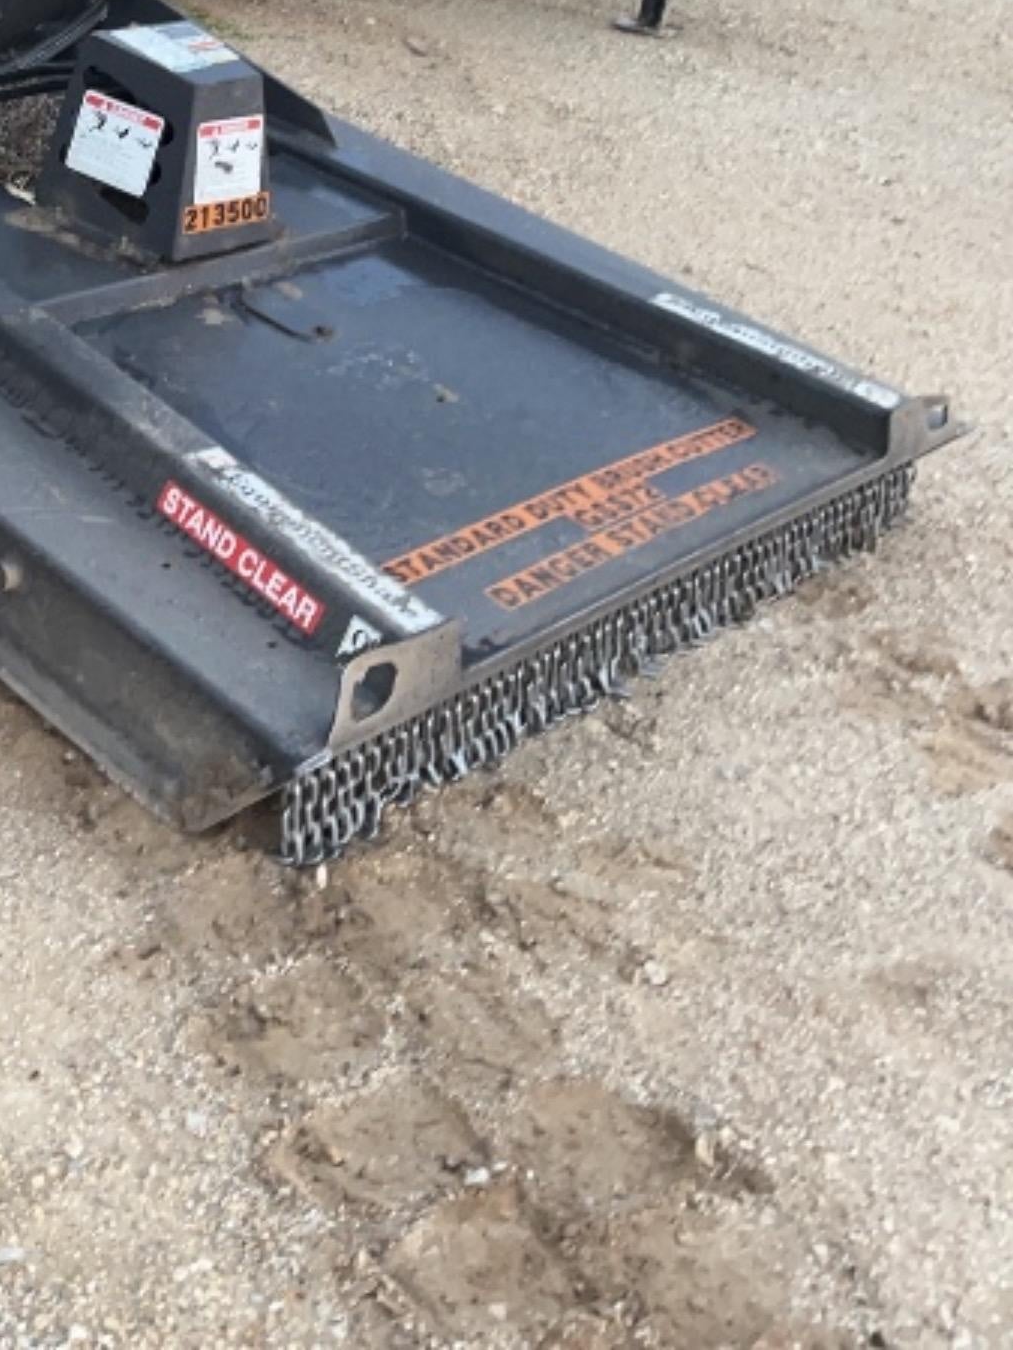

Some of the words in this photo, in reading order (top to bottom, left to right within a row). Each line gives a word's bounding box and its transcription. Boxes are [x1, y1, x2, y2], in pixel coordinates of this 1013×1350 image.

[184, 197, 269, 233] 213500
[163, 487, 238, 560] STAND
[238, 548, 318, 629] CLEAR
[382, 513, 527, 584] STANDARD
[526, 482, 592, 520] DUTY
[489, 539, 614, 607] DANGER
